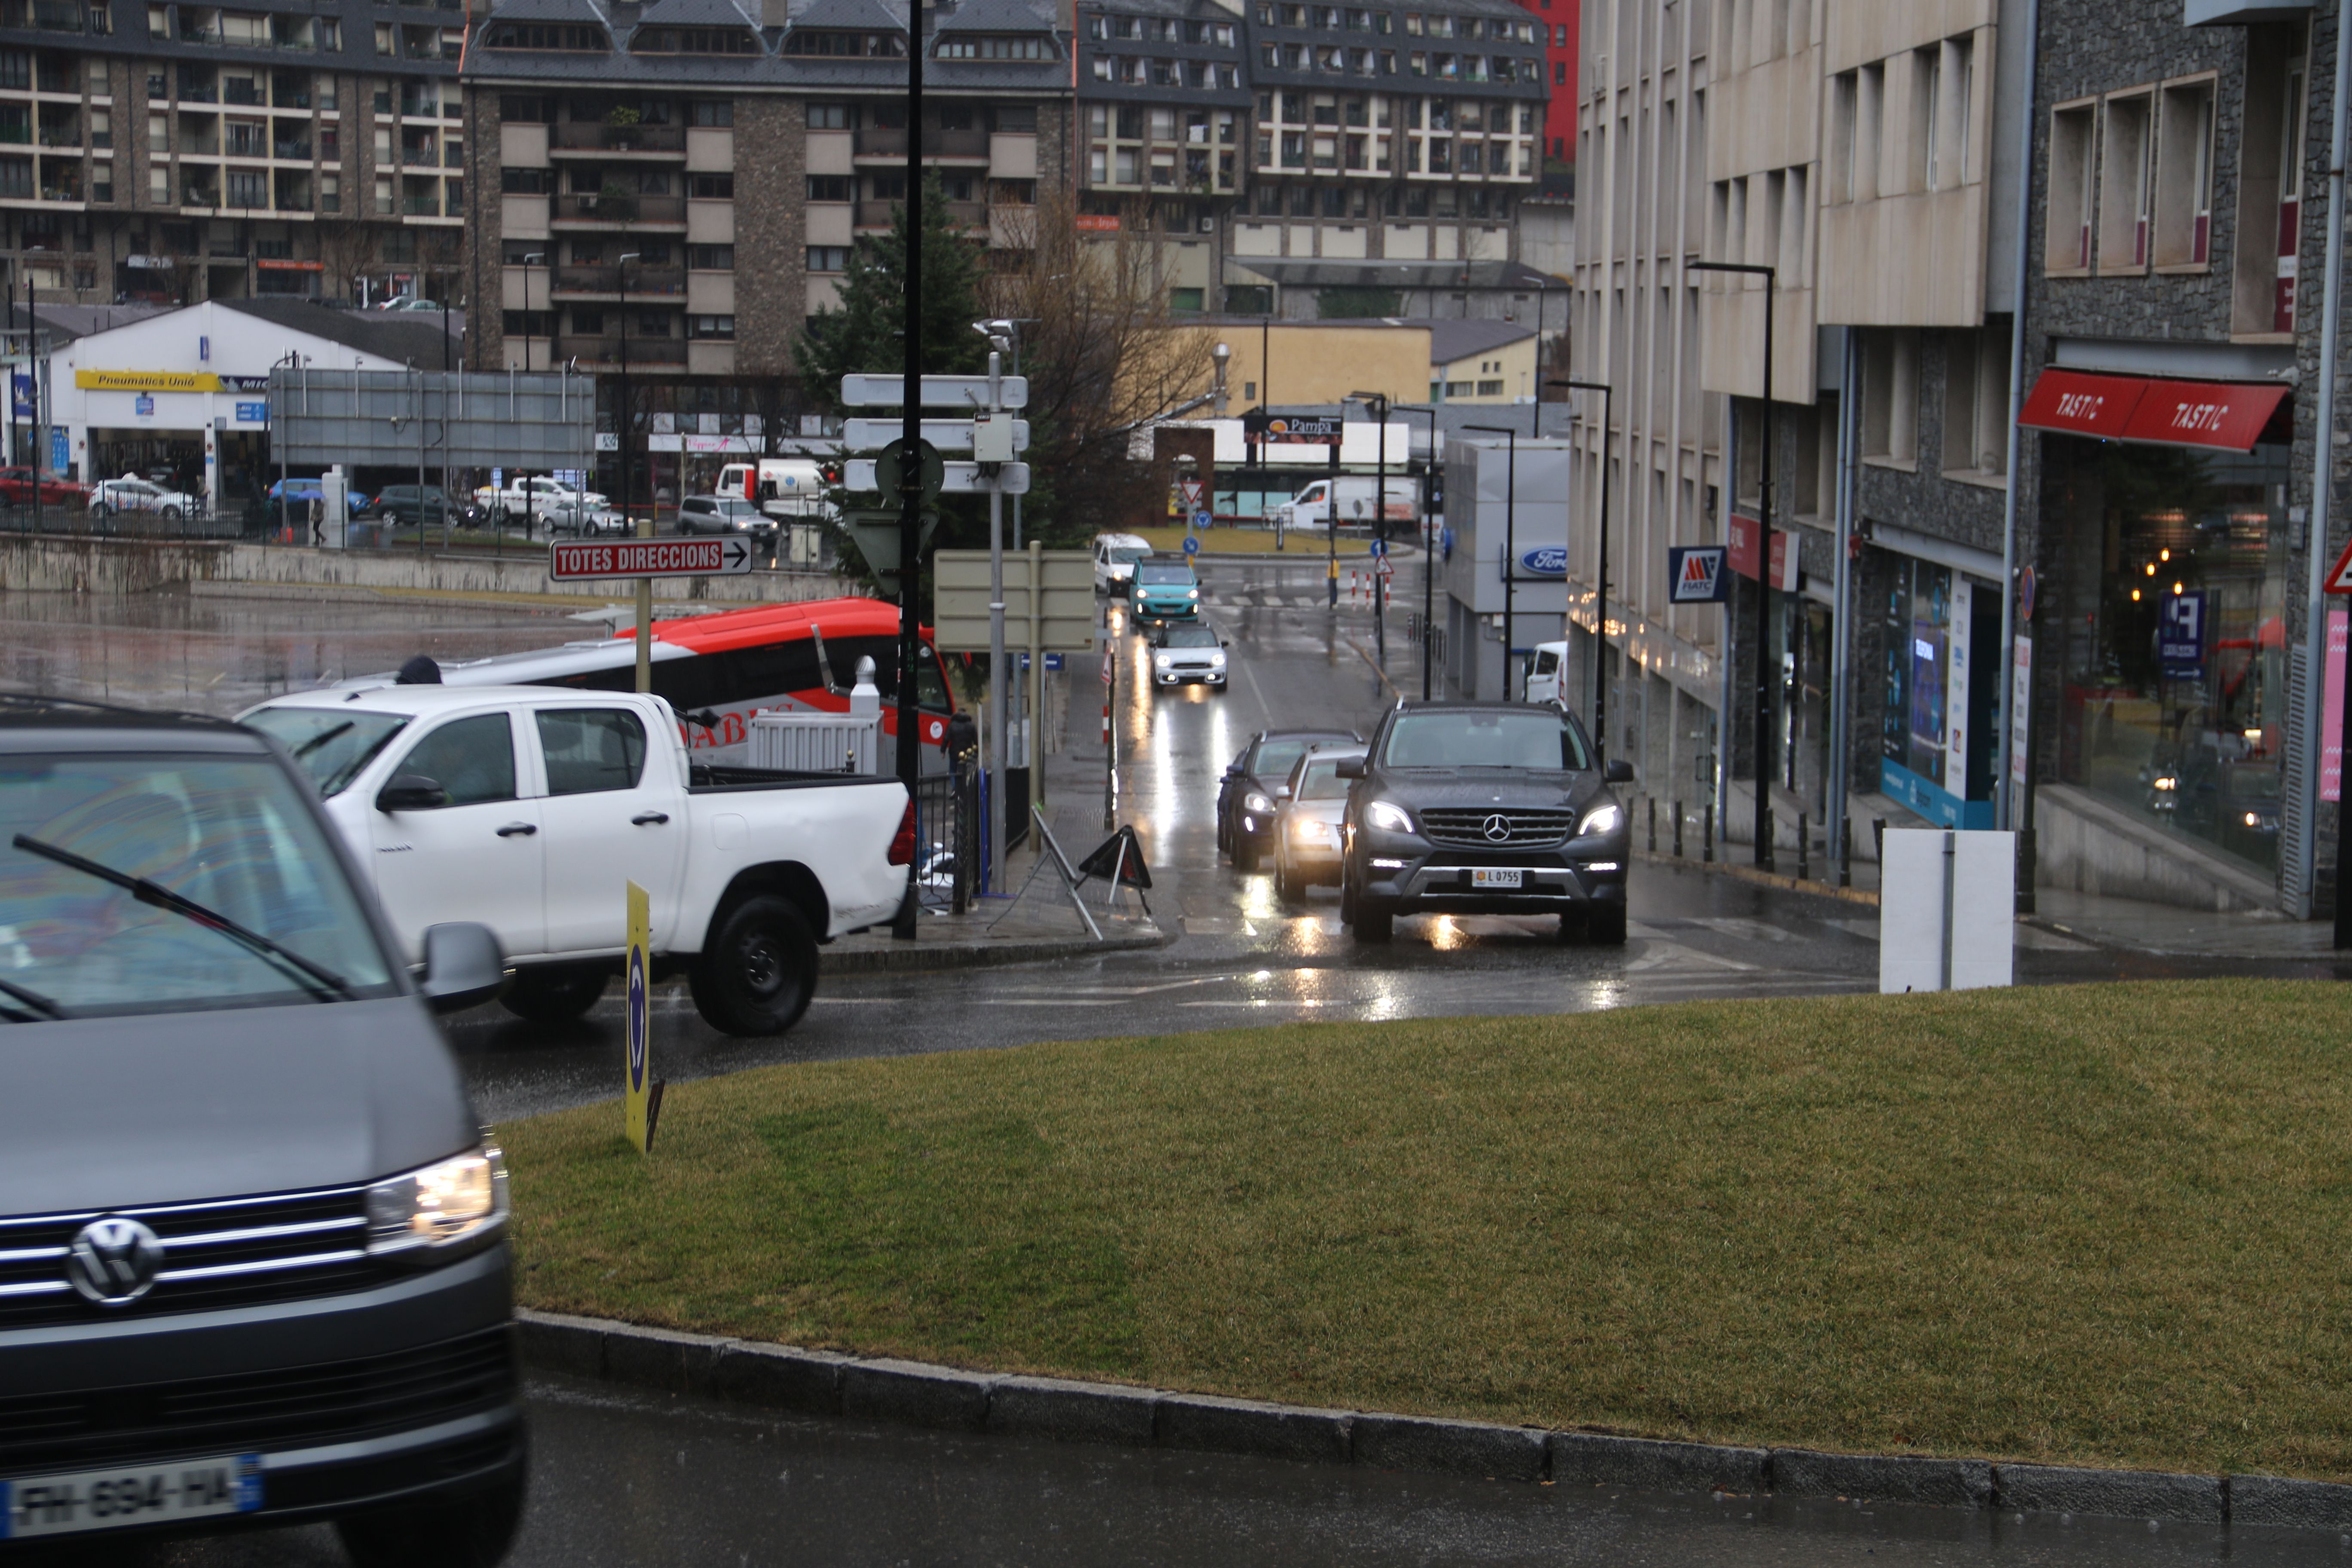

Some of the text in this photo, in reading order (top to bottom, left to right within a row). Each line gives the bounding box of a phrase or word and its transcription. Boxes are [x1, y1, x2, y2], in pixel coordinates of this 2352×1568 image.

[168, 375, 195, 387] Unió
[2056, 393, 2104, 420] TASTIC
[2171, 403, 2229, 431] TASTIC
[1292, 419, 1332, 435] Pampa
[559, 544, 720, 572] TOTES DIRECCIONS
[1682, 581, 1712, 591] FIATC
[1488, 872, 1519, 882] L 0755
